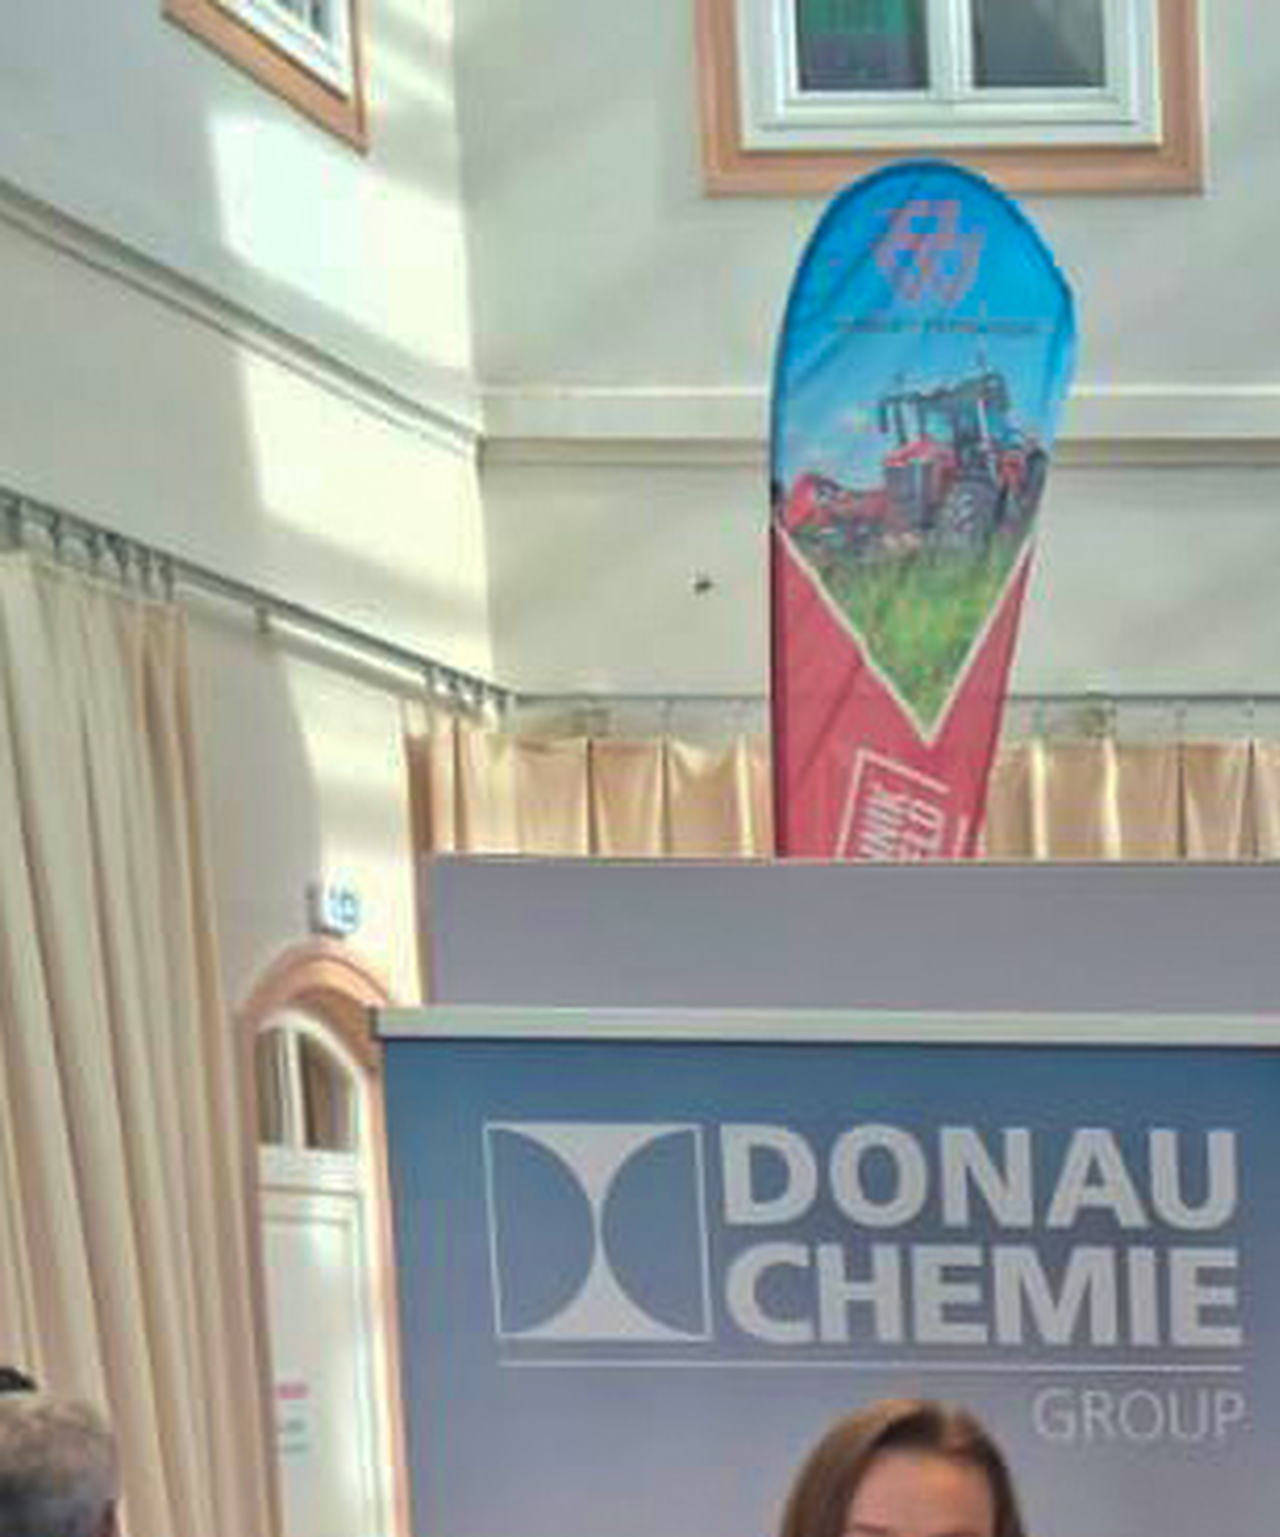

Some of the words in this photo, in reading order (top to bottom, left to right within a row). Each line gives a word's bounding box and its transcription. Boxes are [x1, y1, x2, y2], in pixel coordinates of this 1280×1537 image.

[719, 1123, 1238, 1231] DONAU
[725, 1242, 1243, 1347] CHEMIE
[1033, 1387, 1245, 1441] GROUP
